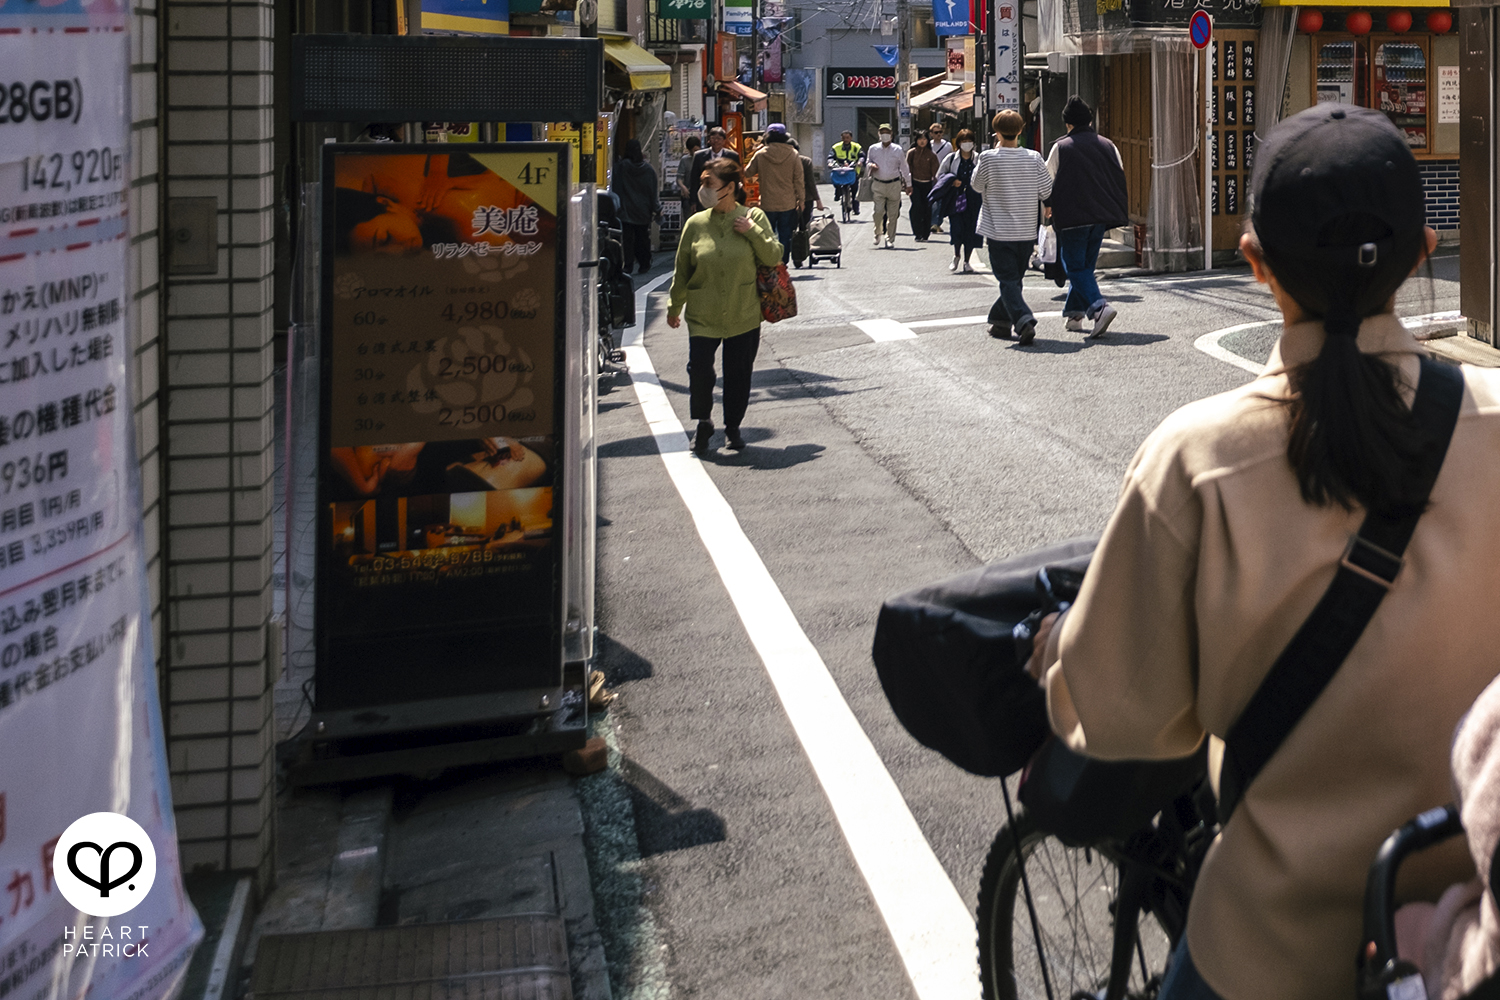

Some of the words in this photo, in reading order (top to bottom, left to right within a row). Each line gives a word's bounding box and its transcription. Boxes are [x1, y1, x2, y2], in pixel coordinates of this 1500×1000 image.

[935, 20, 968, 28] FINLANDS
[517, 162, 550, 185] 4F
[472, 205, 540, 237] 美庵
[432, 240, 544, 259] リラクゼーション
[353, 285, 435, 300] アロマオイル
[441, 300, 509, 324] 4,980
[438, 354, 507, 378] 2,500
[438, 404, 507, 427] 2,500
